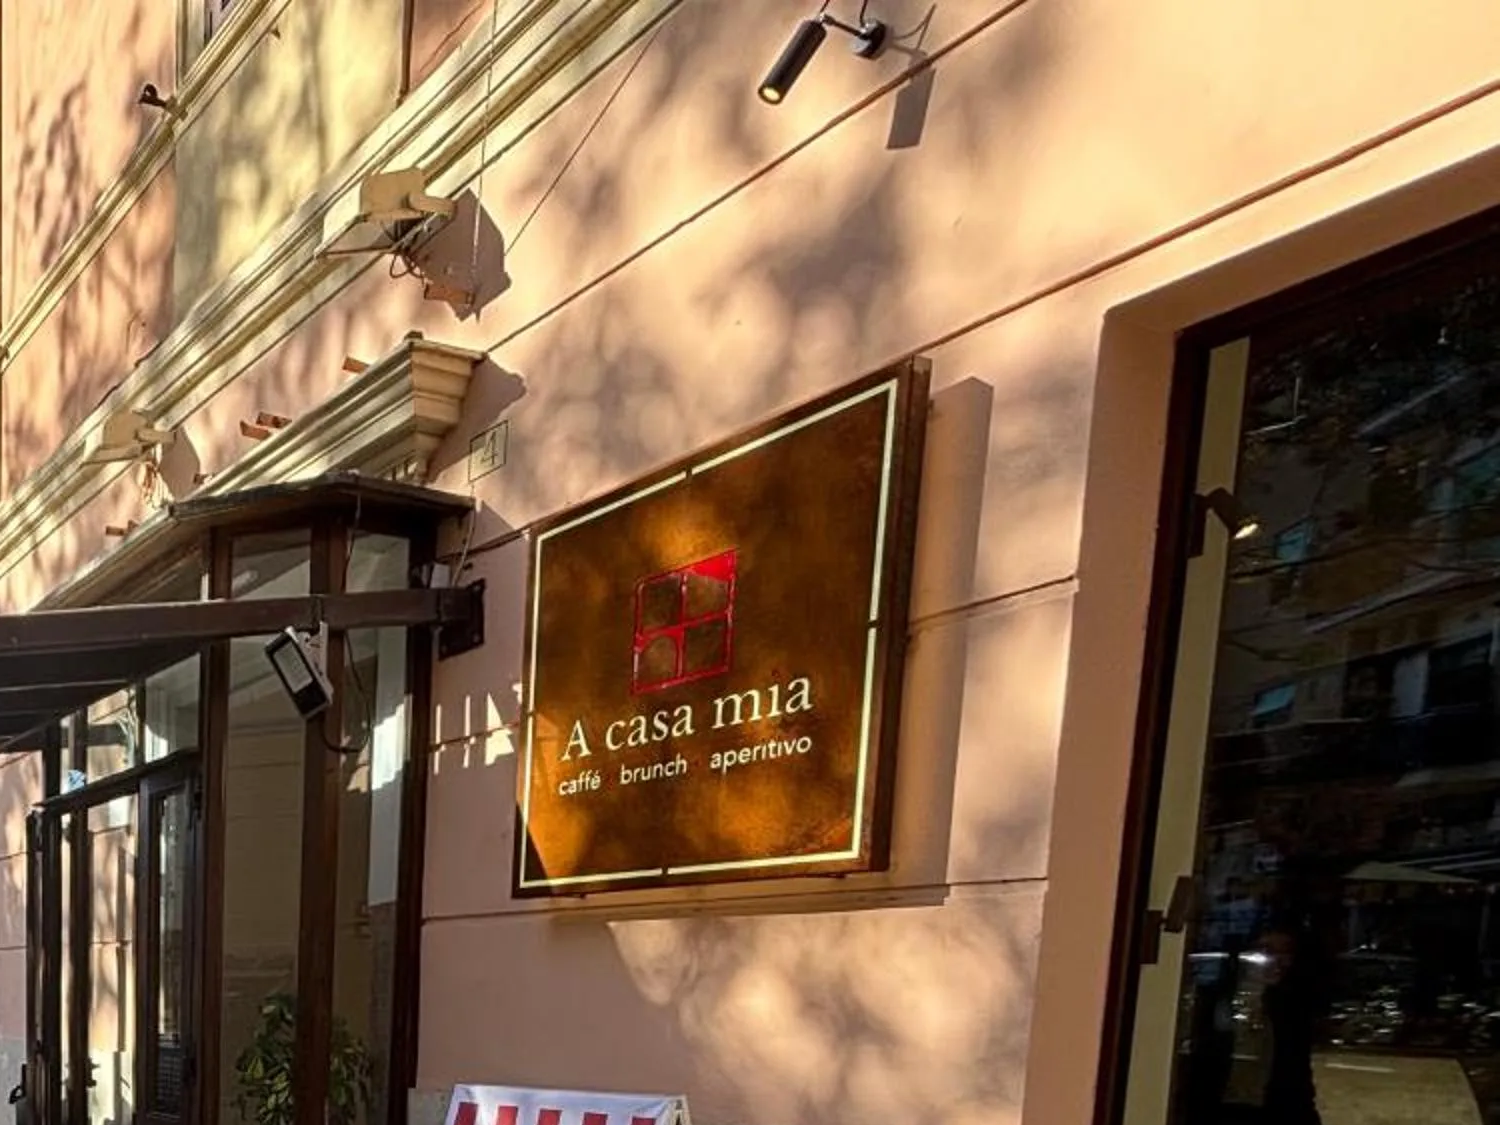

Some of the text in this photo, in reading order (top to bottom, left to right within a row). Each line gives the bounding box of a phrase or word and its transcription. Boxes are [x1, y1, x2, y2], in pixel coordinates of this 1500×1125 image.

[480, 430, 498, 465] 4
[560, 676, 814, 761] A casa mia
[619, 753, 688, 785] brunch
[709, 735, 813, 776] aperitivo
